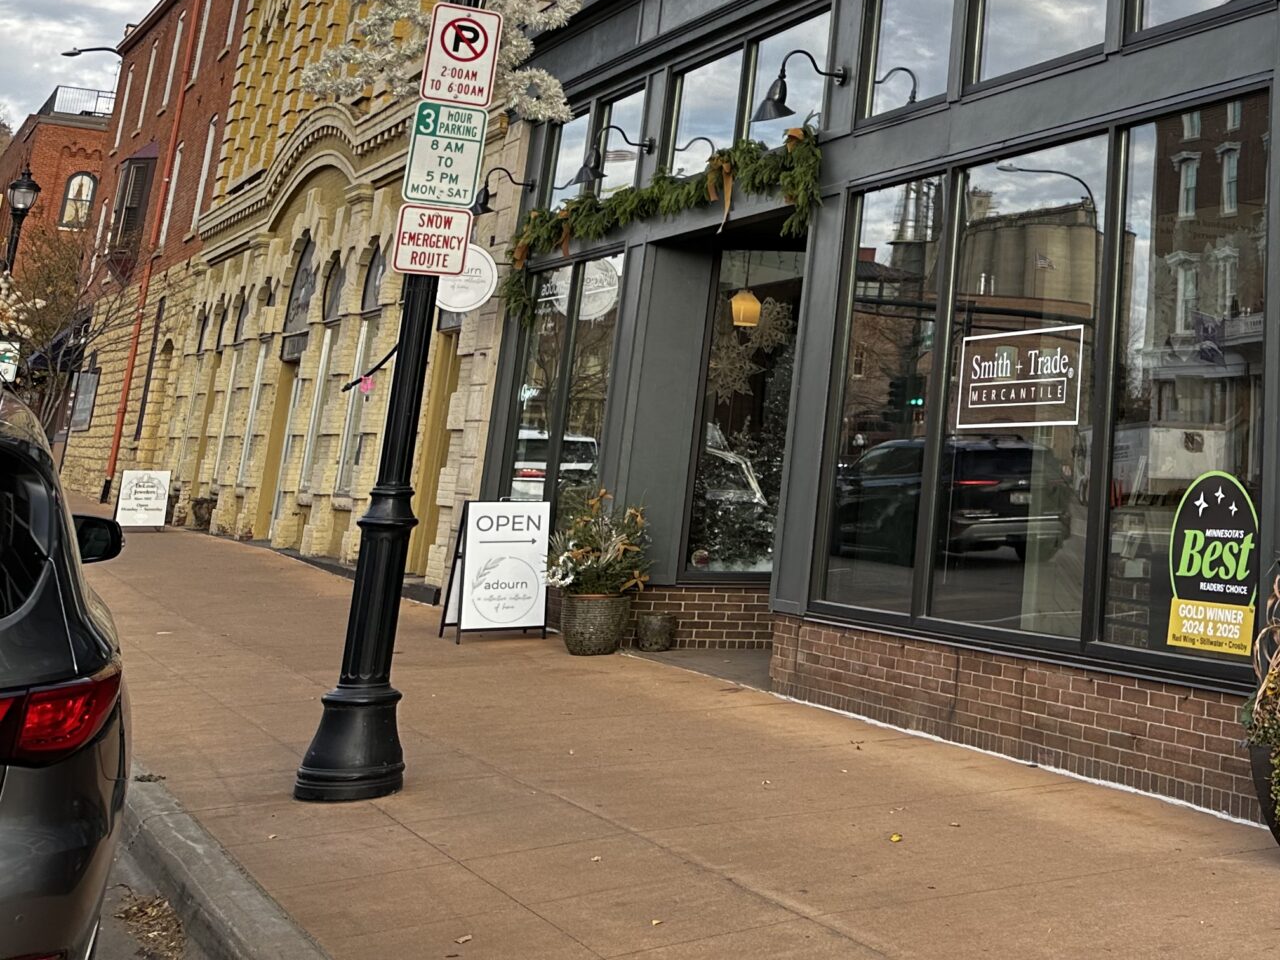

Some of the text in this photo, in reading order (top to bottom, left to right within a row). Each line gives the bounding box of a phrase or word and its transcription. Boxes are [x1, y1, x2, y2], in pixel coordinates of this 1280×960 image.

[440, 66, 478, 81] 2:00AM
[430, 79, 484, 97] TO 6:00AM
[419, 109, 435, 133] 3
[439, 122, 478, 138] PARKING
[431, 140, 464, 154] 8 AM
[437, 156, 453, 168] TO
[426, 171, 459, 185] 5 PM
[411, 184, 436, 196] MON
[447, 188, 469, 199] SAT
[418, 213, 453, 230] SNOW
[401, 231, 464, 251] EMERGENCY
[410, 251, 449, 268] ROUTE
[971, 352, 1011, 379] Smith
[1028, 347, 1069, 375] Trade
[971, 385, 1062, 401] MERCANTILE
[476, 515, 542, 532] OPEN
[1205, 529, 1245, 539] MINNESOTA'S
[1175, 530, 1255, 581] Best
[484, 579, 528, 590] adourn
[1200, 582, 1248, 595] READERS' CHOICE
[1179, 604, 1244, 624] GOLD WINNER
[1182, 620, 1240, 639] 2024 & 2025
[1183, 635, 1196, 645] Wing
[1200, 637, 1224, 647] Stillwater
[1228, 641, 1247, 652] Crosby
